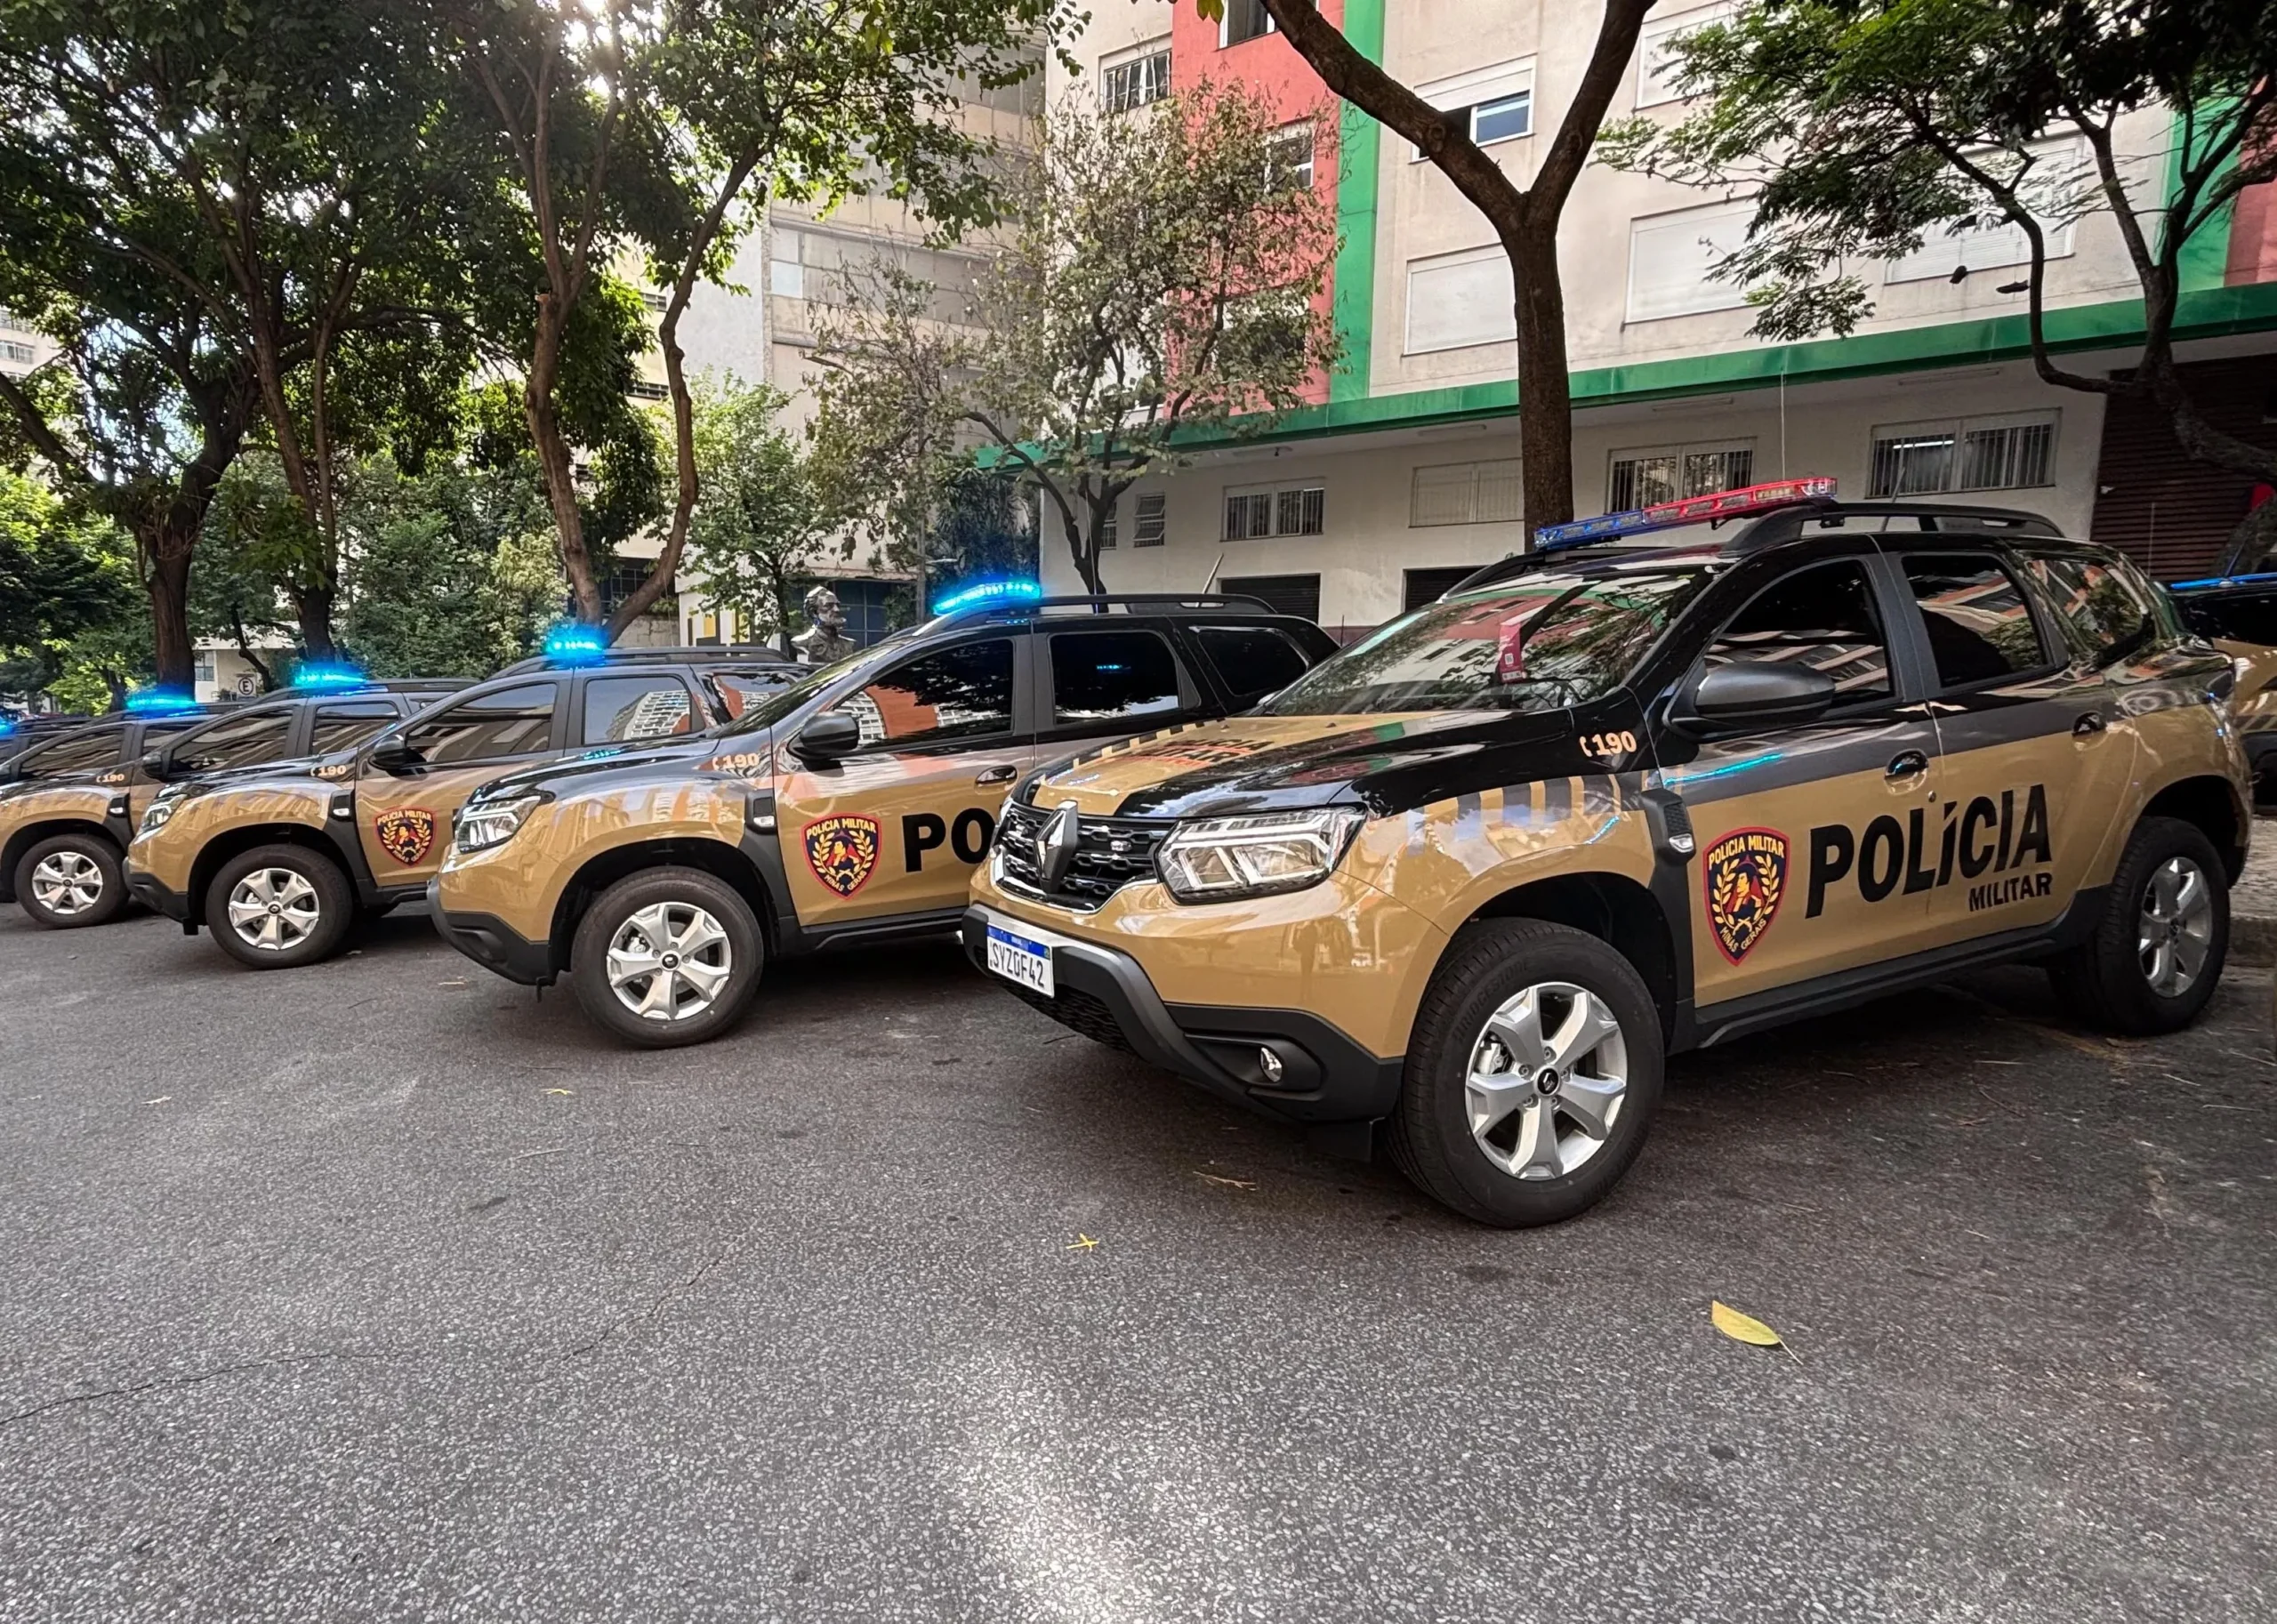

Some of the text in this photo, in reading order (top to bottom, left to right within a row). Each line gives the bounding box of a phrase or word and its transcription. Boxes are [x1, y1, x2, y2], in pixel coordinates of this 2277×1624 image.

[242, 680, 250, 692] E
[1592, 730, 1637, 756] 190
[318, 765, 347, 776] 190
[722, 752, 760, 769] 190
[103, 773, 125, 783] 190
[841, 818, 877, 833] MILITAR
[1748, 835, 1785, 858] MILITAR
[1805, 784, 2052, 920] POLÍCIA
[824, 870, 867, 892] MINAS GERAIS
[1967, 872, 2054, 912] MILITAR
[1720, 918, 1766, 953] MINAS GERAIS
